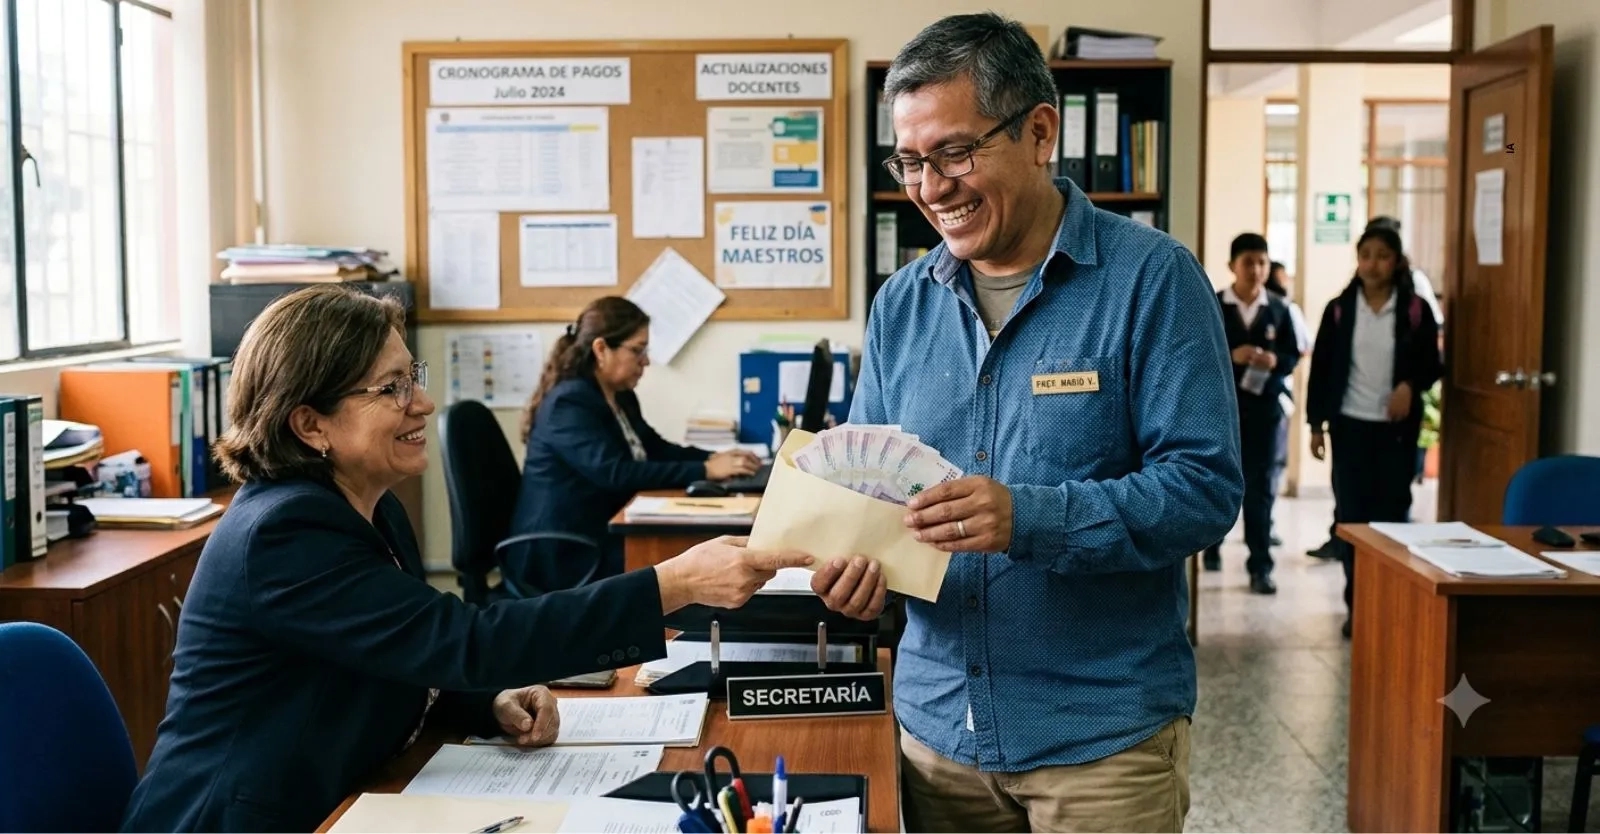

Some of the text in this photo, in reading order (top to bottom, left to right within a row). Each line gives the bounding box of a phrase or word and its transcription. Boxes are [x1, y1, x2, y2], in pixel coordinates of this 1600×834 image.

[438, 65, 622, 80] CRONOGRAMA DE PAGOS
[701, 62, 827, 75] ACTUALIZACIONES
[494, 86, 566, 99] Julio 2024
[728, 81, 800, 94] DOCENTES
[730, 220, 816, 241] FELIZ DÍA
[722, 248, 824, 264] MAESTROS
[742, 681, 872, 706] SECRETARÍA
